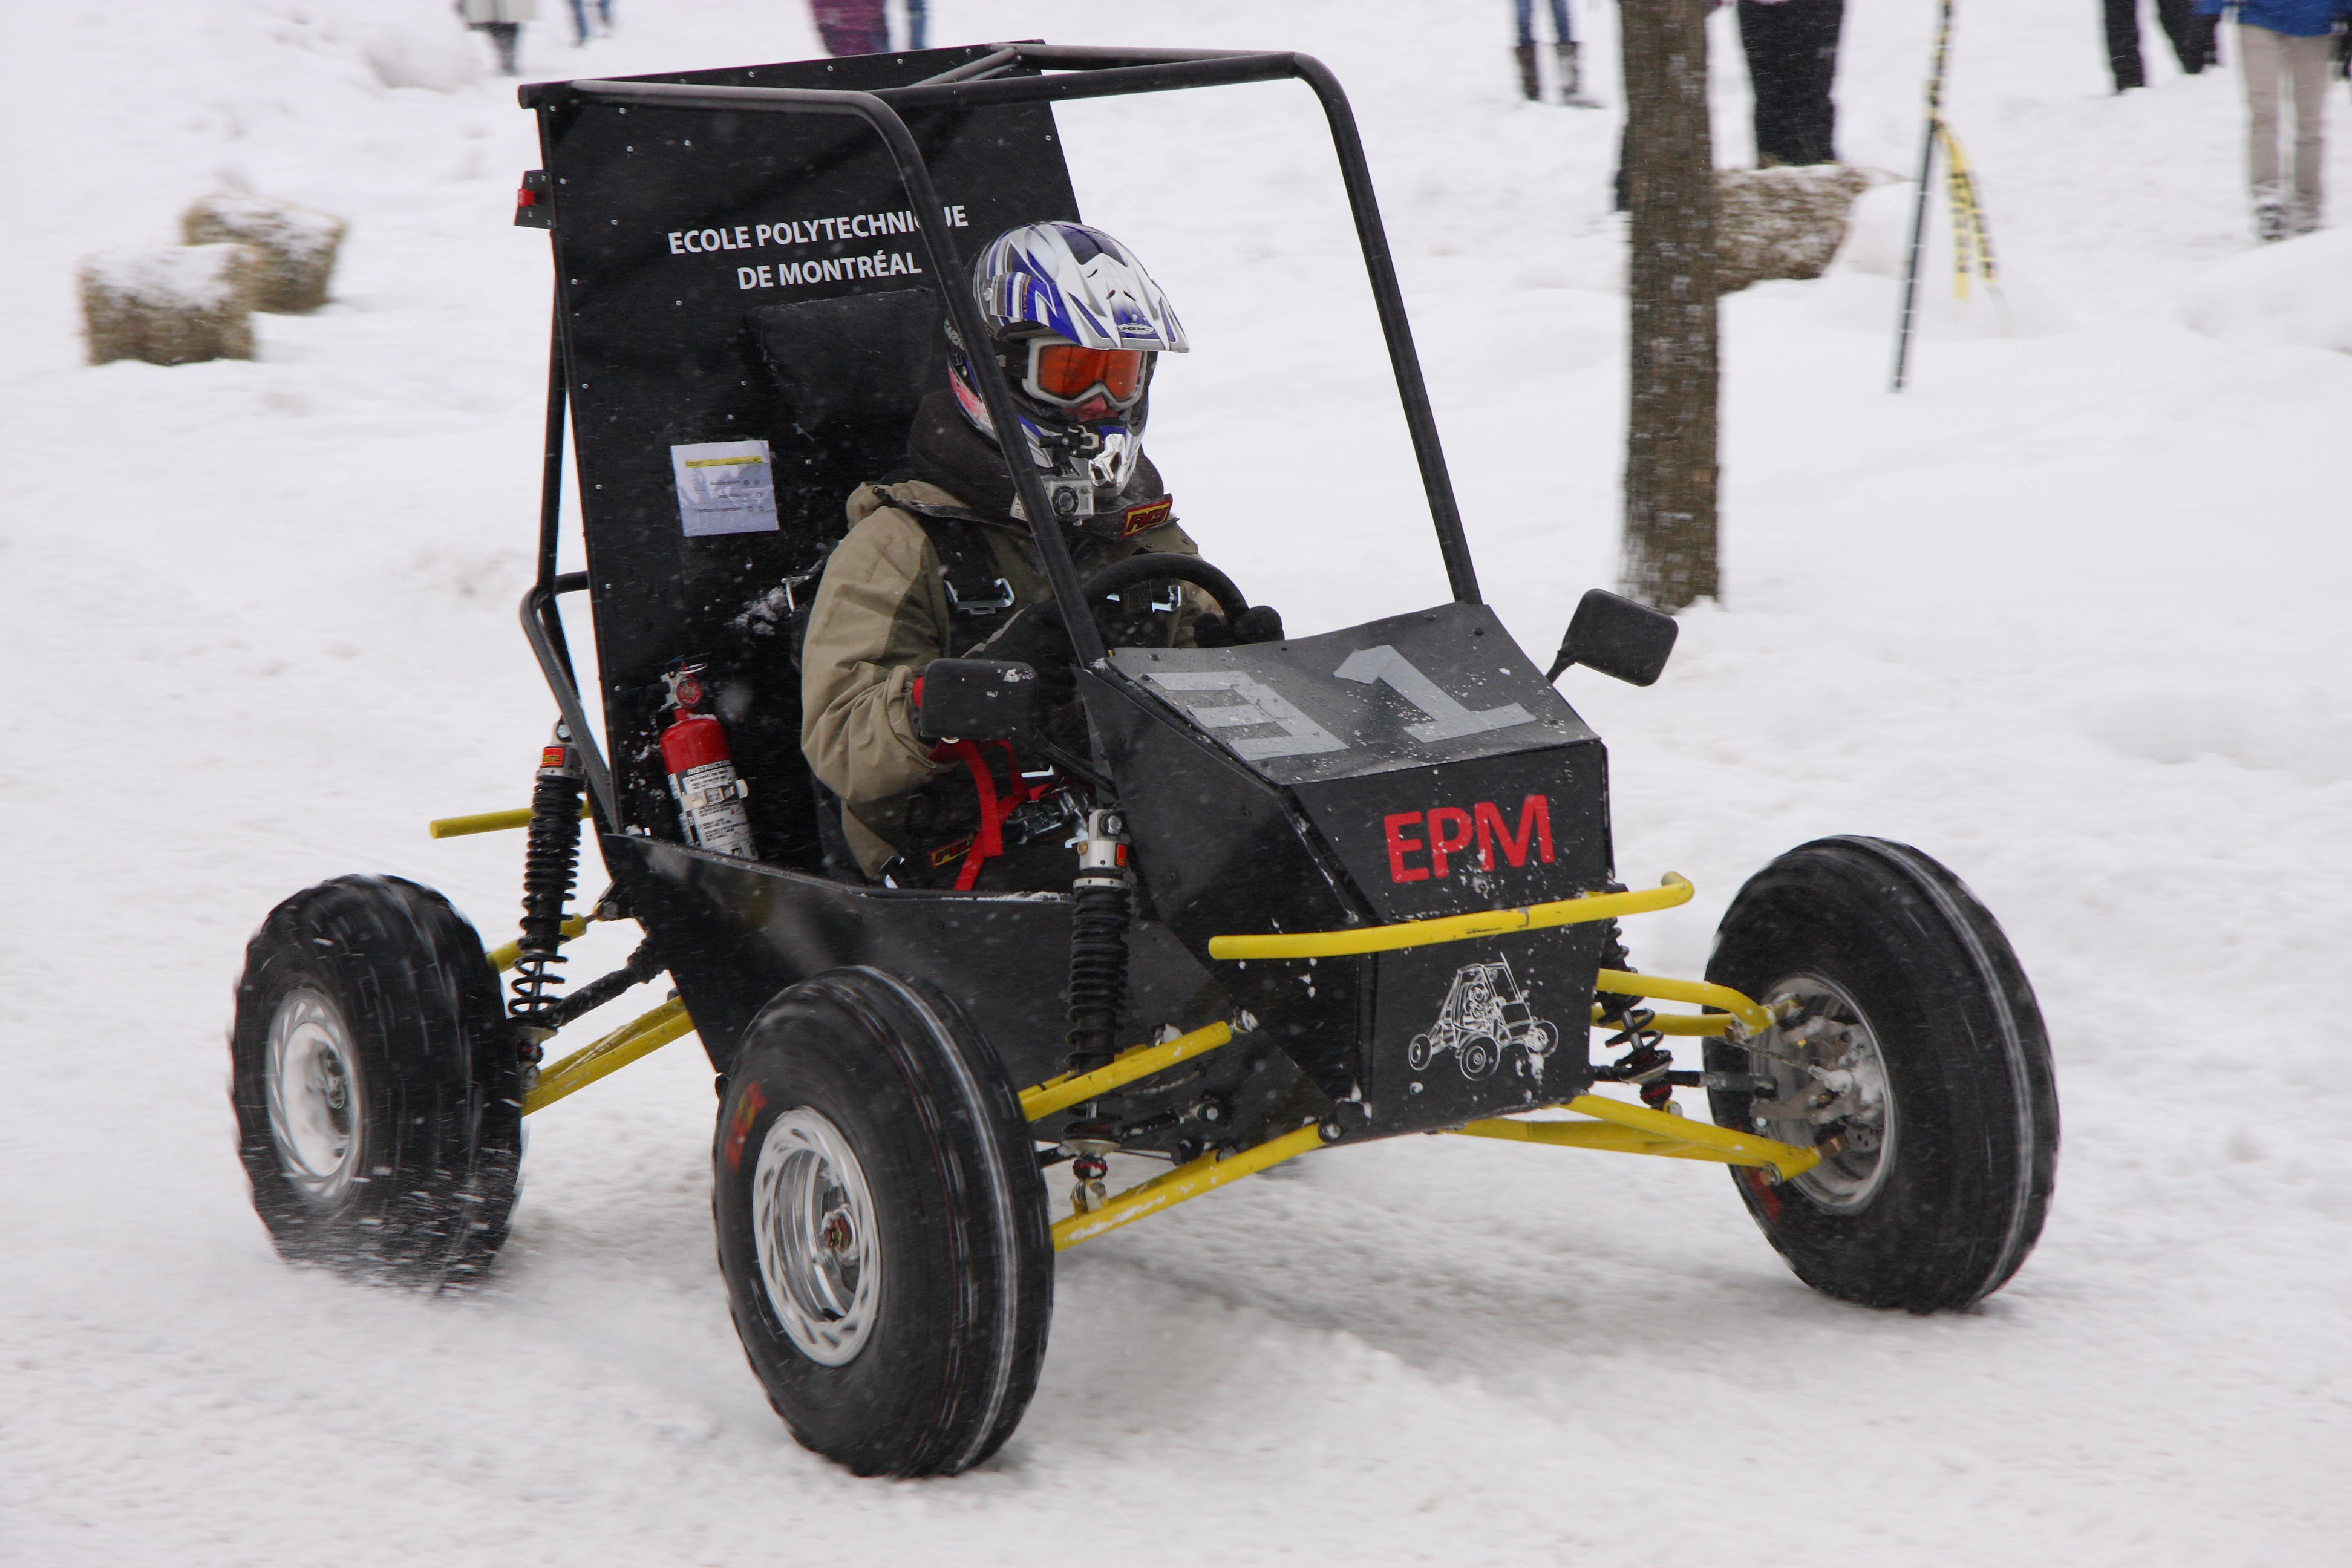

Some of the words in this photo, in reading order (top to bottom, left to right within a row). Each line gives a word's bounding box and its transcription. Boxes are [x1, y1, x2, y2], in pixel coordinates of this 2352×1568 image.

[668, 226, 751, 254] ECOLE
[756, 205, 969, 246] POLYTECHNIE
[737, 265, 773, 290] DE
[779, 250, 923, 286] MONTRÉAL
[1383, 794, 1555, 884] EPM
